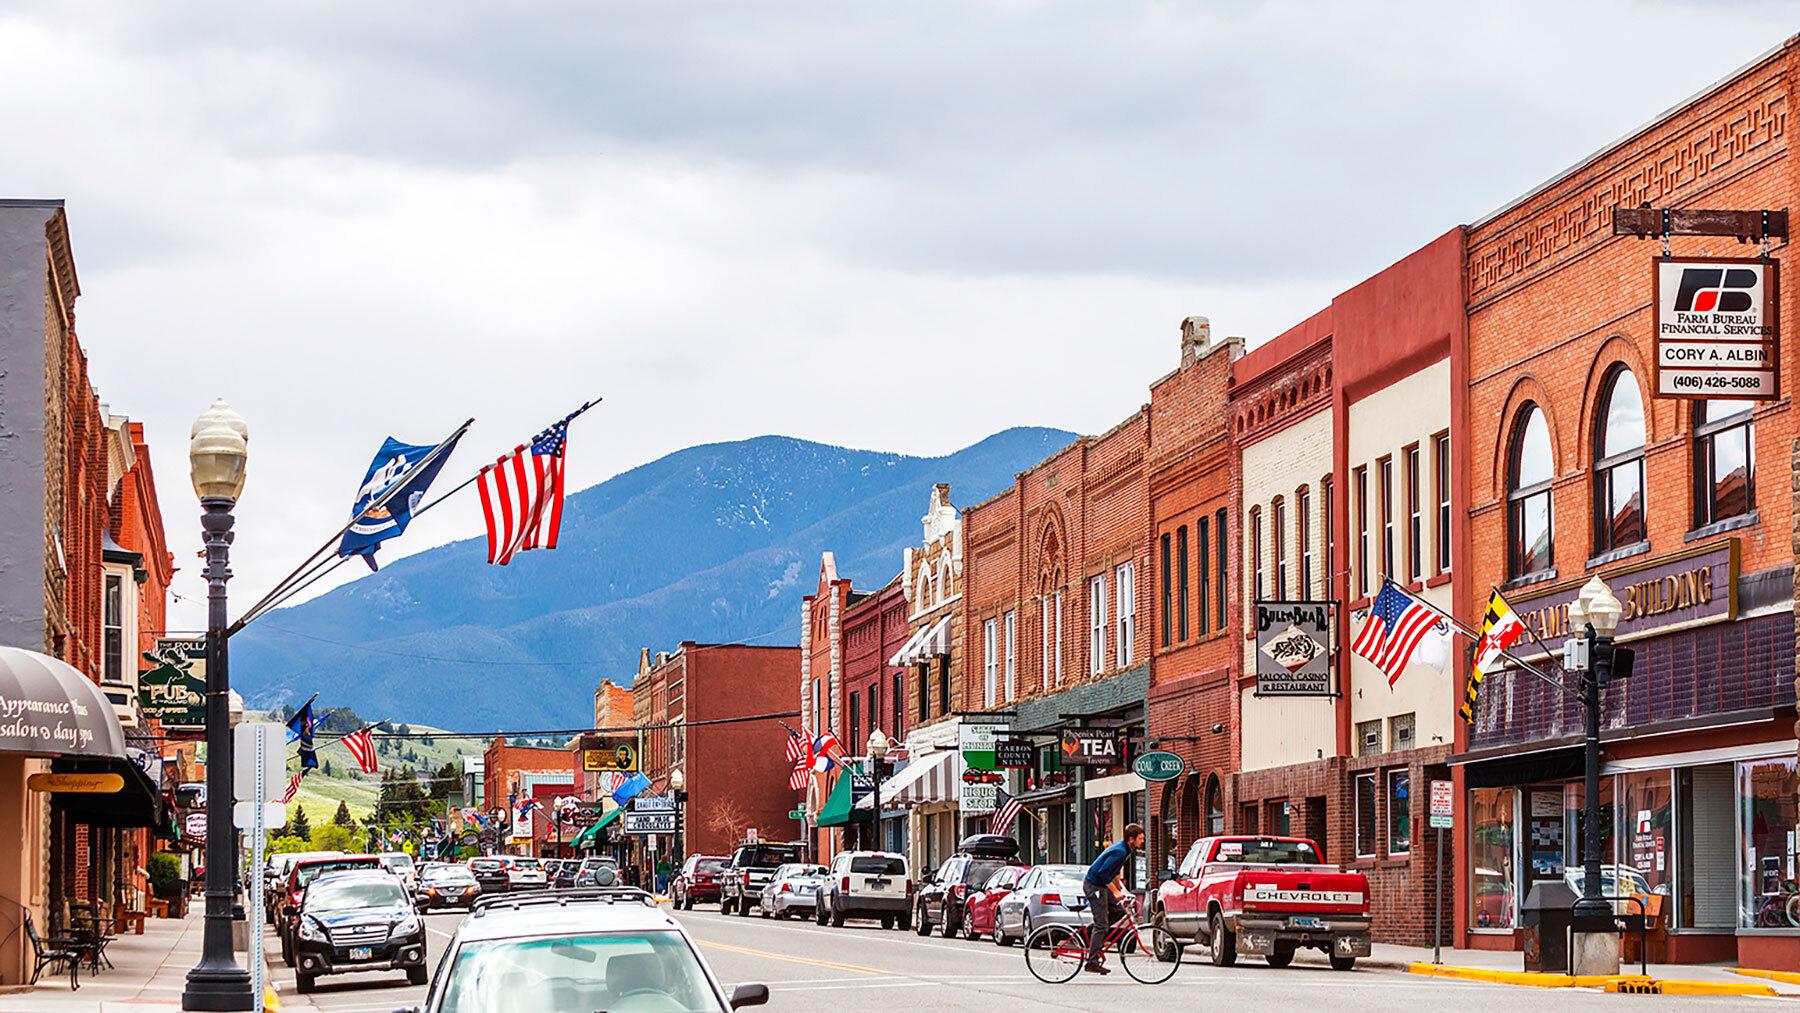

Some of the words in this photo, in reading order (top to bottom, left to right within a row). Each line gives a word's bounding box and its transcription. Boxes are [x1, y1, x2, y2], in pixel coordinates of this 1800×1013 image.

[1677, 313, 1709, 324] FARM
[1713, 313, 1757, 325] BUREAU
[1661, 323, 1721, 335] FINANCIAL
[1723, 324, 1773, 336] SERVICES
[1665, 348, 1706, 361] CORY
[1709, 349, 1723, 361] A.
[1726, 349, 1768, 362] ALBIN
[1673, 375, 1703, 389] (406)
[1704, 376, 1761, 388] 426-5088
[1624, 566, 1712, 622] BUILDING
[1296, 672, 1328, 681] CASINO
[150, 684, 189, 700] PUB
[1271, 683, 1325, 692] RESTAURANT
[0, 717, 39, 738] salon
[54, 720, 77, 749] day
[79, 728, 94, 749] spa
[1063, 728, 1094, 738] Phoenix
[1095, 729, 1115, 738] Pearl
[1080, 738, 1116, 756] TEA
[1087, 755, 1111, 764] Tavern
[1160, 760, 1181, 771] CREEK
[963, 786, 997, 798] LIQUO
[966, 798, 996, 809] STOR
[1255, 891, 1352, 902] CHEVROLET
